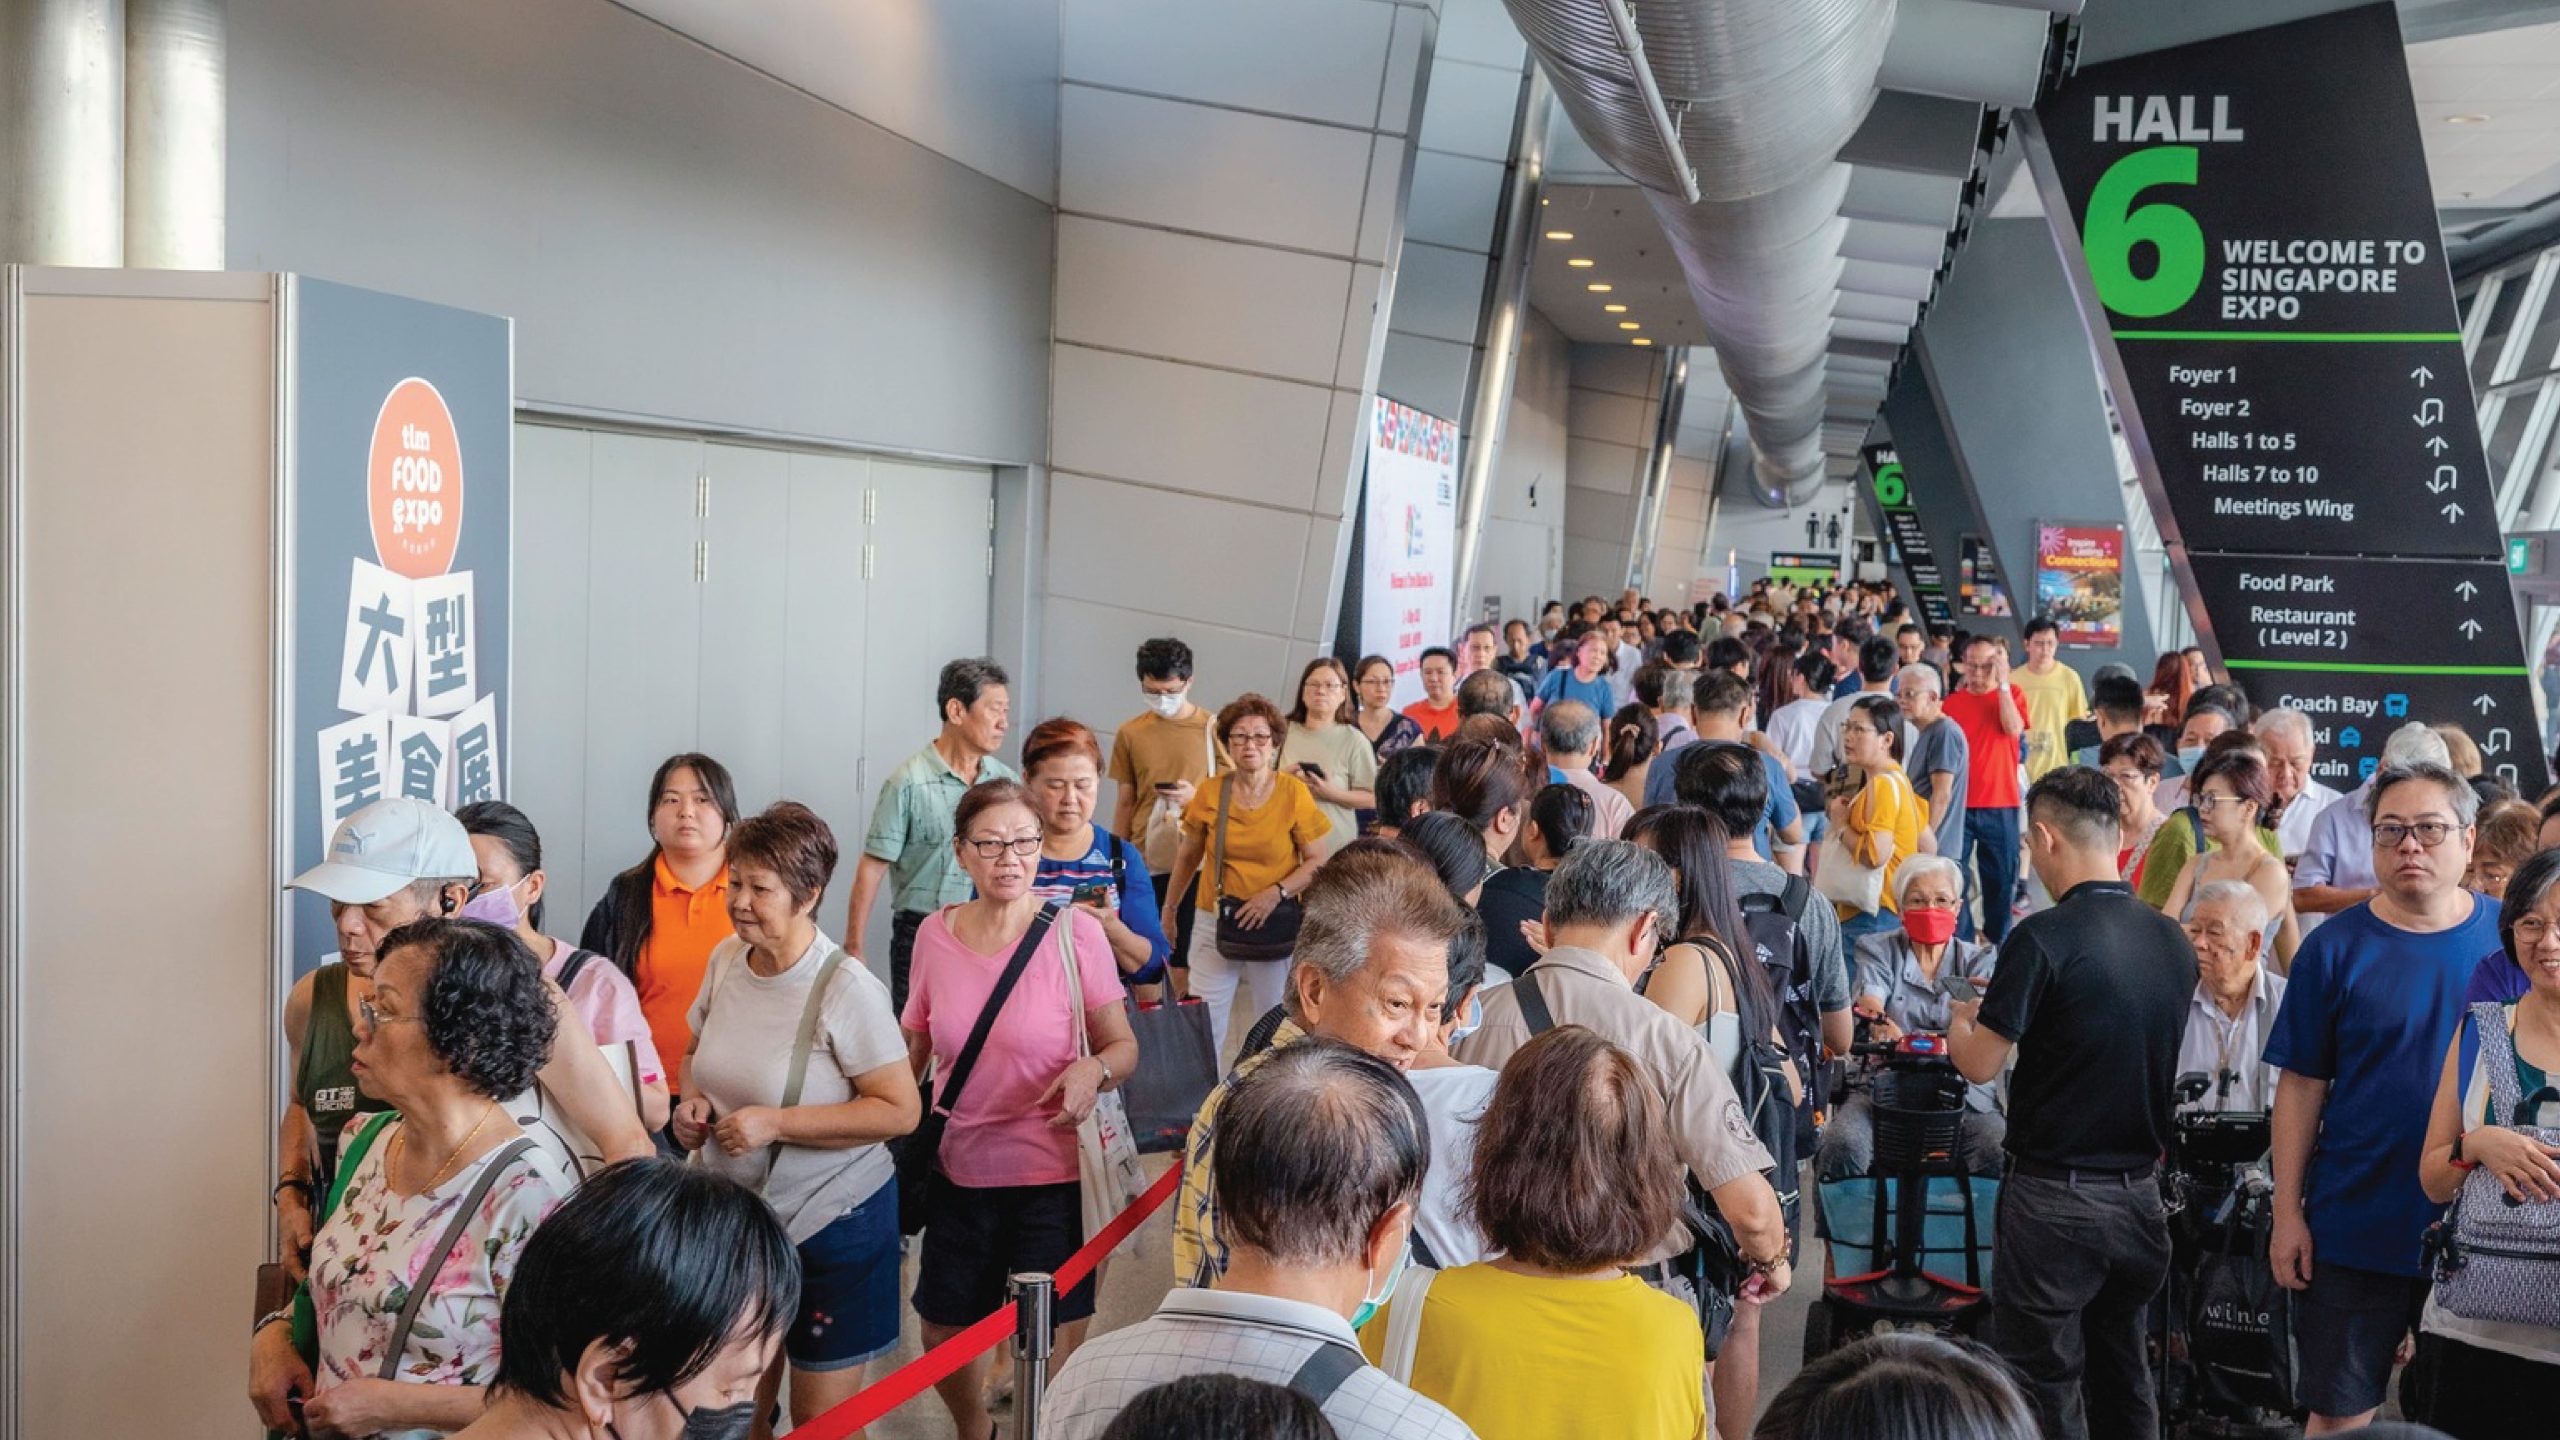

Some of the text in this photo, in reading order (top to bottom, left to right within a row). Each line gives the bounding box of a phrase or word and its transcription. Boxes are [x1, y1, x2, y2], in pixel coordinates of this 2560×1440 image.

[2093, 95, 2244, 142] HALL
[2083, 145, 2206, 318] 6
[2222, 240, 2426, 265] WELCOME TO
[2221, 268, 2398, 293] SINGAPORE
[2221, 296, 2300, 320] EXPO
[2169, 365, 2237, 388] Foyer 1
[2180, 398, 2250, 420] Foyer 2
[2192, 431, 2296, 450] Halls 1 to 5
[1876, 450, 1898, 464] HA
[392, 455, 442, 493] FOOD
[1874, 463, 1905, 506] 6
[2203, 465, 2319, 484] Halls 7 to 10
[392, 497, 442, 533] expo
[2214, 497, 2355, 521] Meetings Wing
[2239, 573, 2335, 593] Food Park
[2251, 605, 2357, 626] Restaurant
[355, 592, 468, 698] 大型
[2280, 694, 2379, 718] Coach Bay
[2313, 726, 2331, 744] xi
[2311, 759, 2349, 776] rain
[2207, 1302, 2270, 1326] wine
